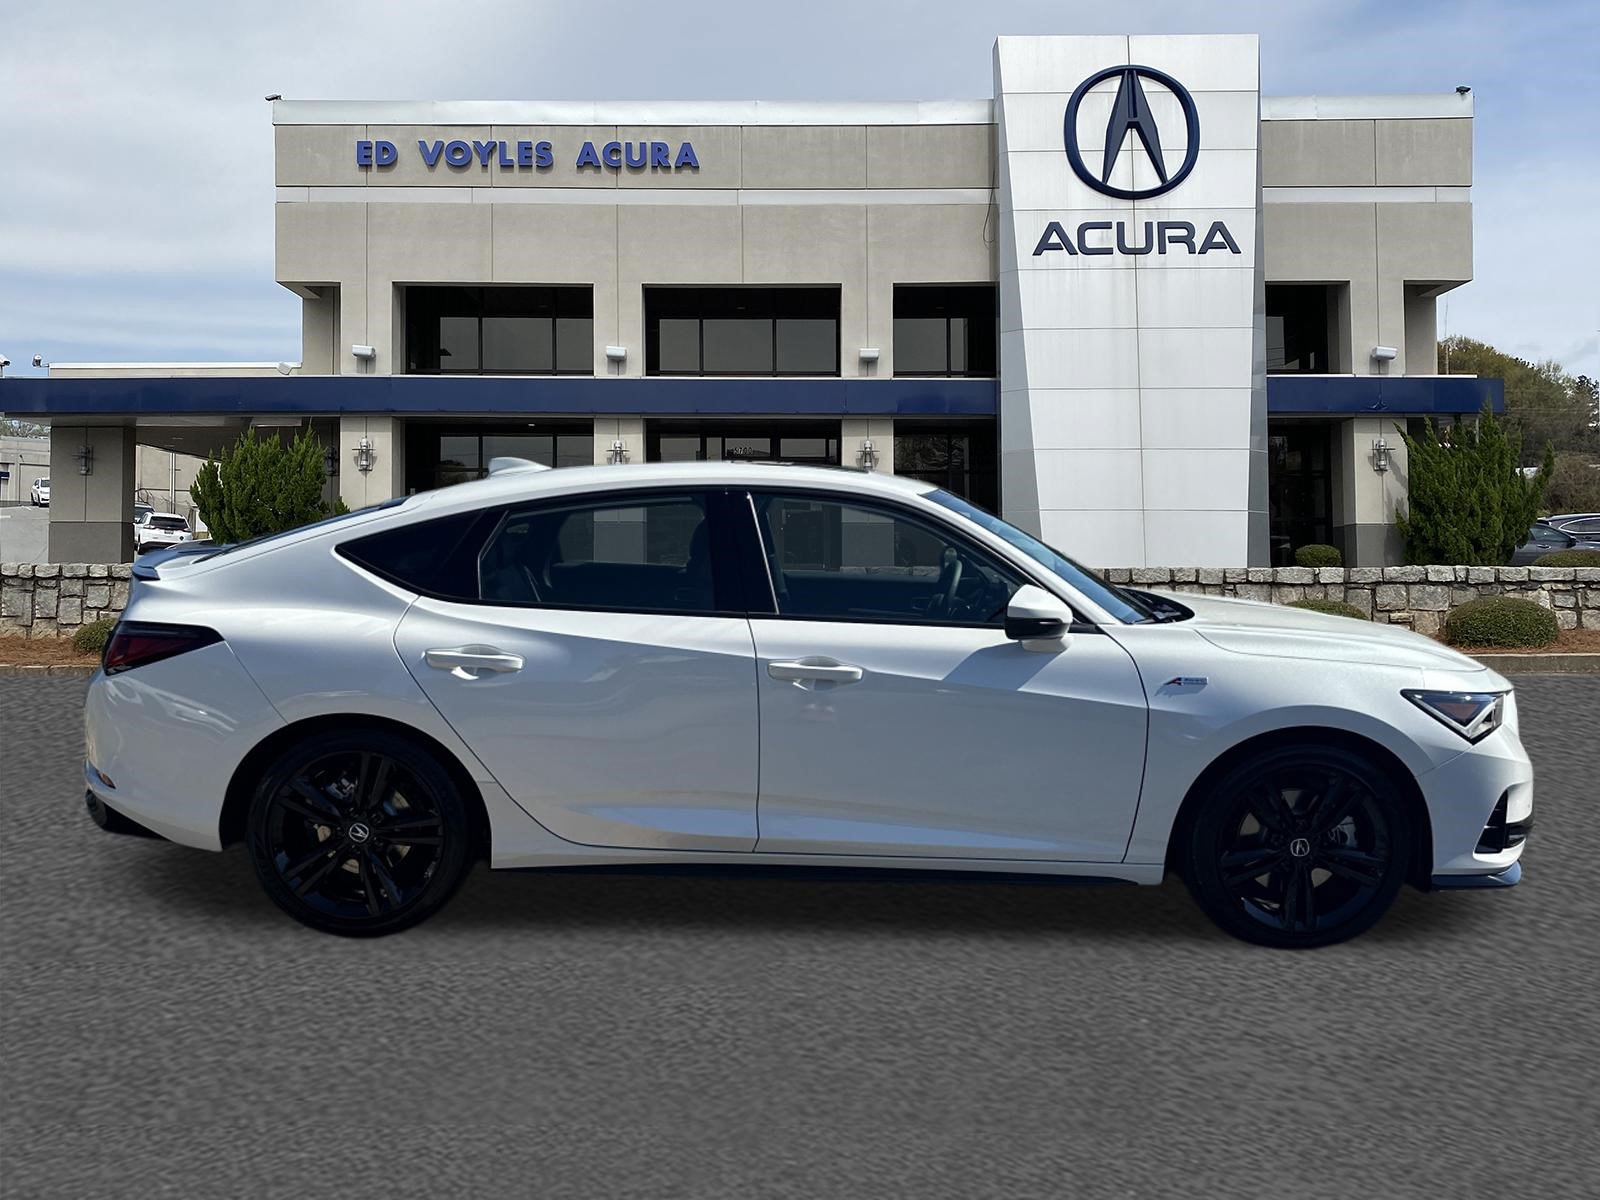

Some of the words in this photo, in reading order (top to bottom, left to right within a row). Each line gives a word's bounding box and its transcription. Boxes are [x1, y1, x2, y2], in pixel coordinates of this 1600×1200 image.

[356, 140, 397, 168] ED
[418, 140, 554, 168] VOYLES
[576, 141, 700, 168] ACURA
[1032, 221, 1242, 256] ACURA
